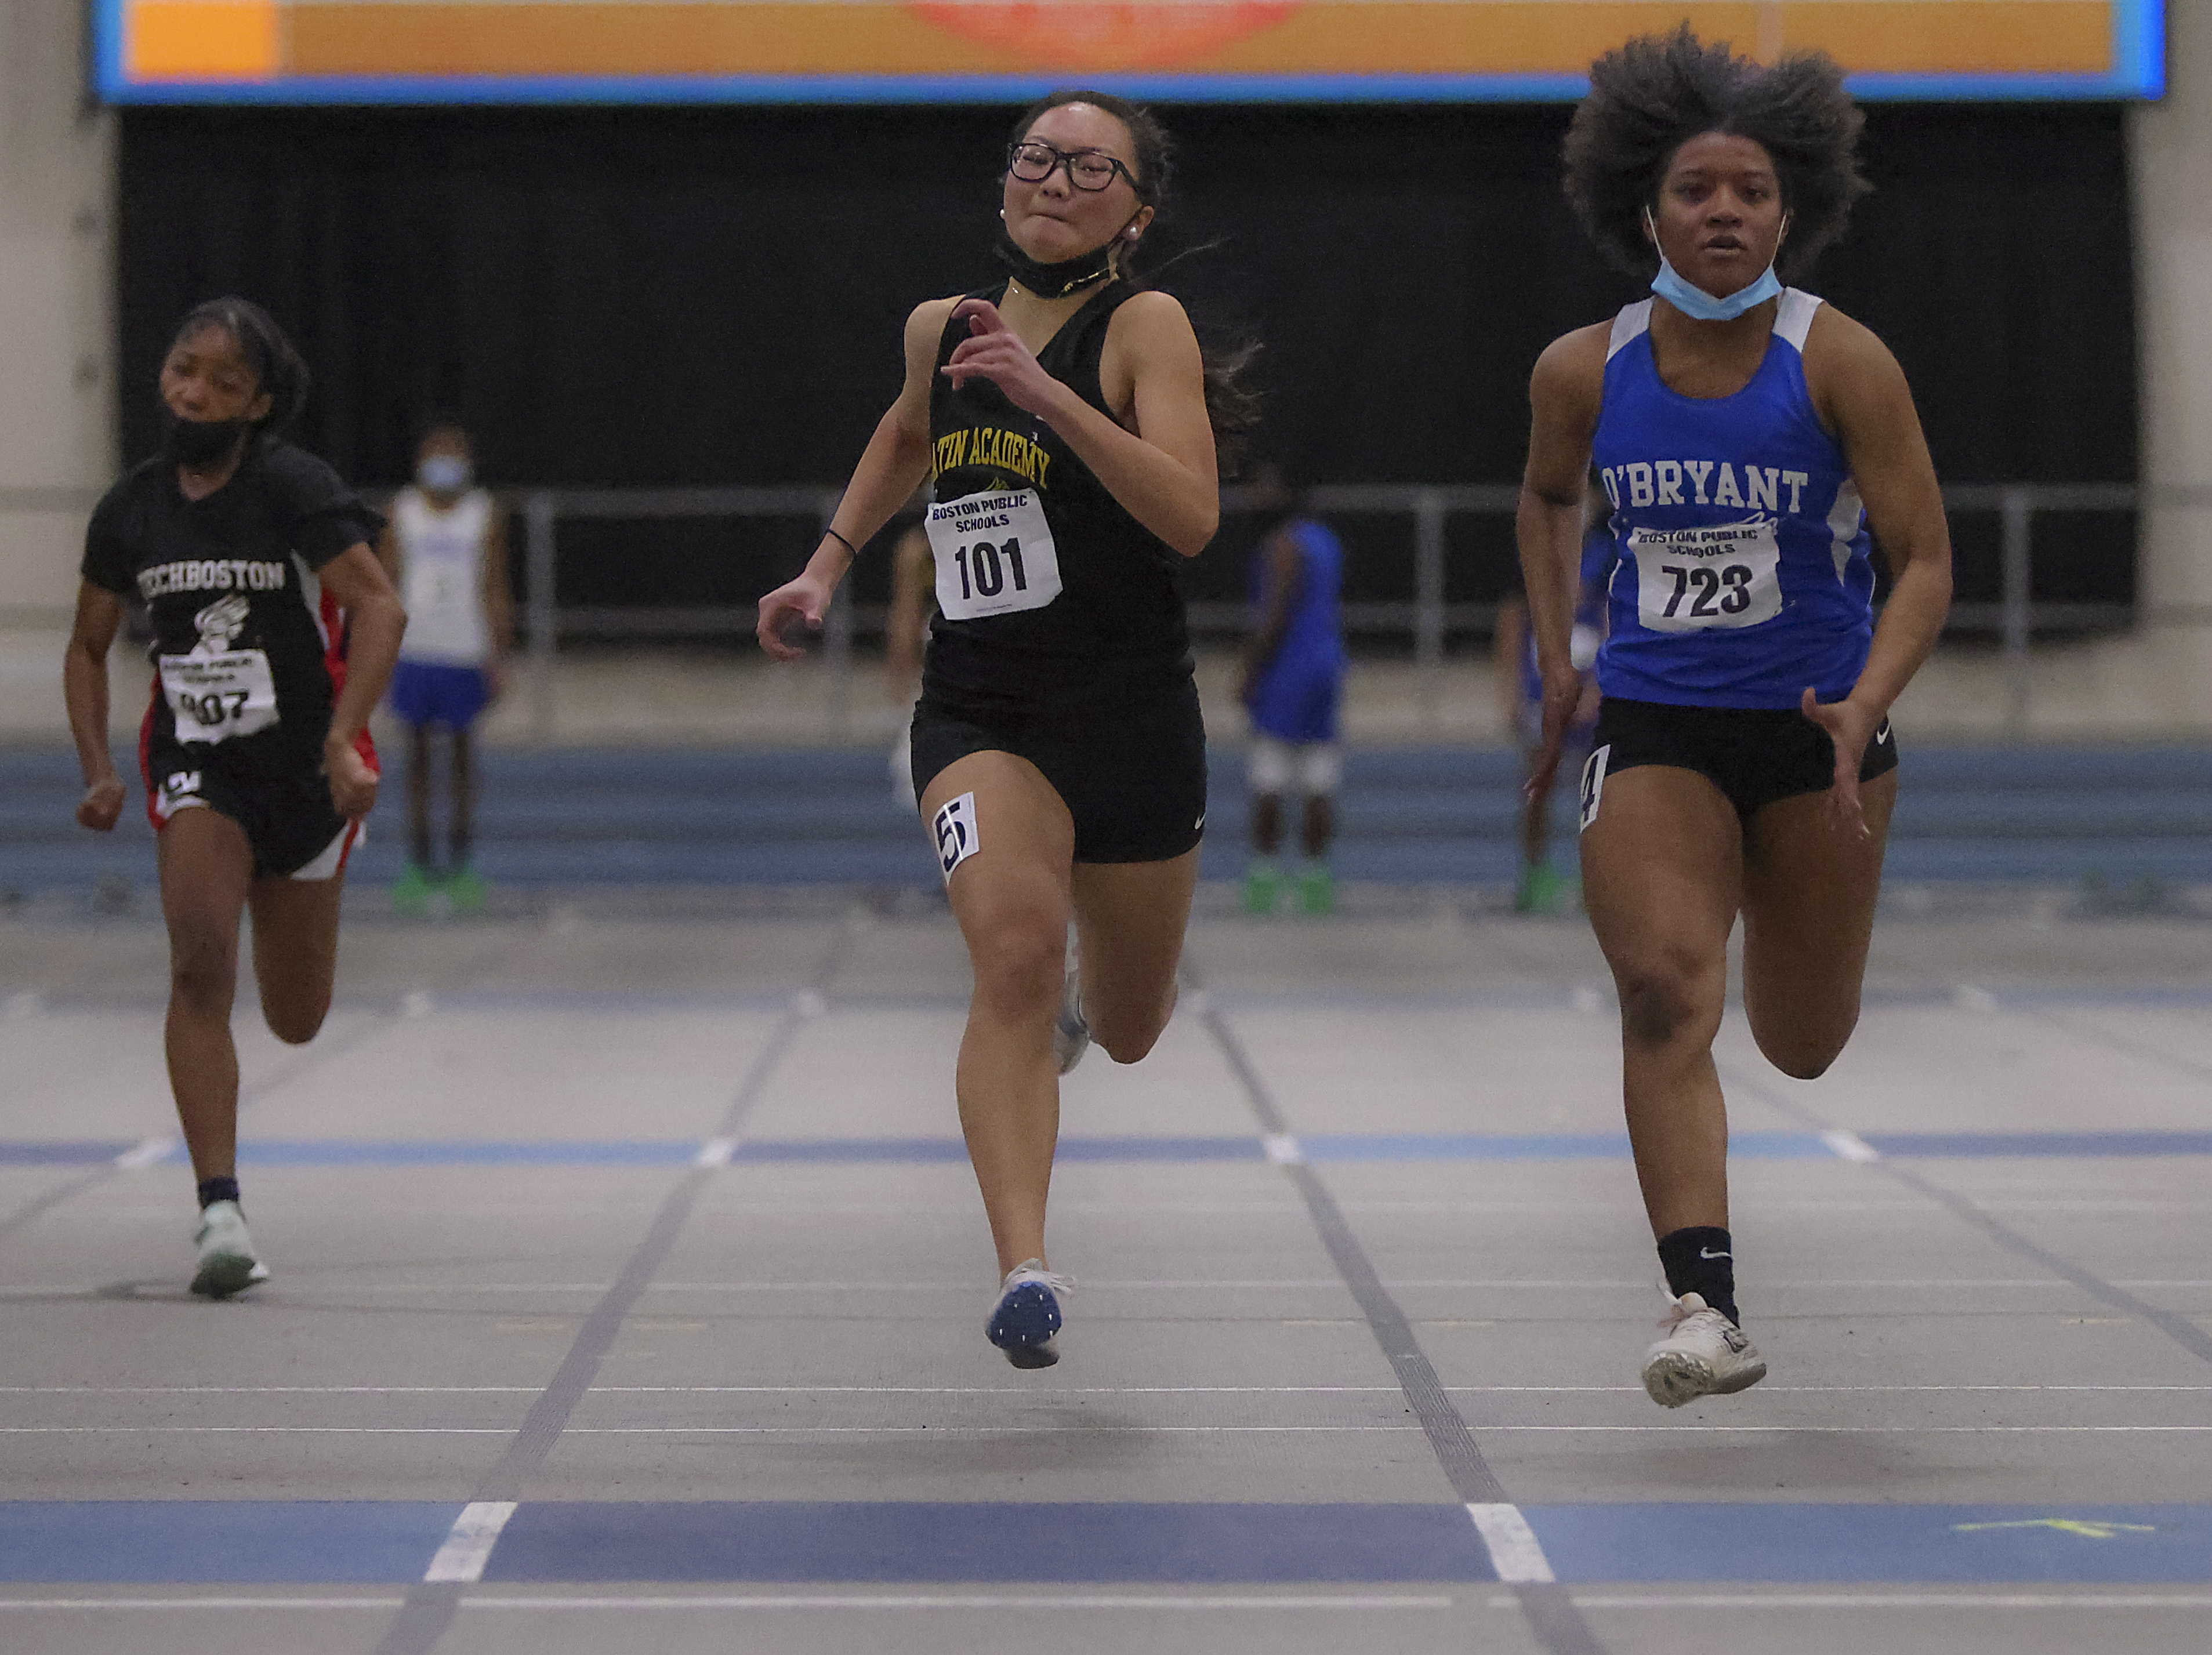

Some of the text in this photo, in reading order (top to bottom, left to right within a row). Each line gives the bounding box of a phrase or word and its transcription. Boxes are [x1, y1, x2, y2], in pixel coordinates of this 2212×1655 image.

[969, 427, 1050, 489] ACADEMY
[933, 495, 1028, 521] BOSTON PUBLIC
[1602, 460, 1808, 513] O'BRYANT
[955, 514, 1010, 532] SCHOOLS
[1638, 529, 1758, 543] BOSTON PUBLIC
[955, 537, 1027, 600] 101
[1666, 544, 1736, 558] SCHOOLS
[1661, 564, 1753, 618] 723
[935, 801, 966, 873] 5
